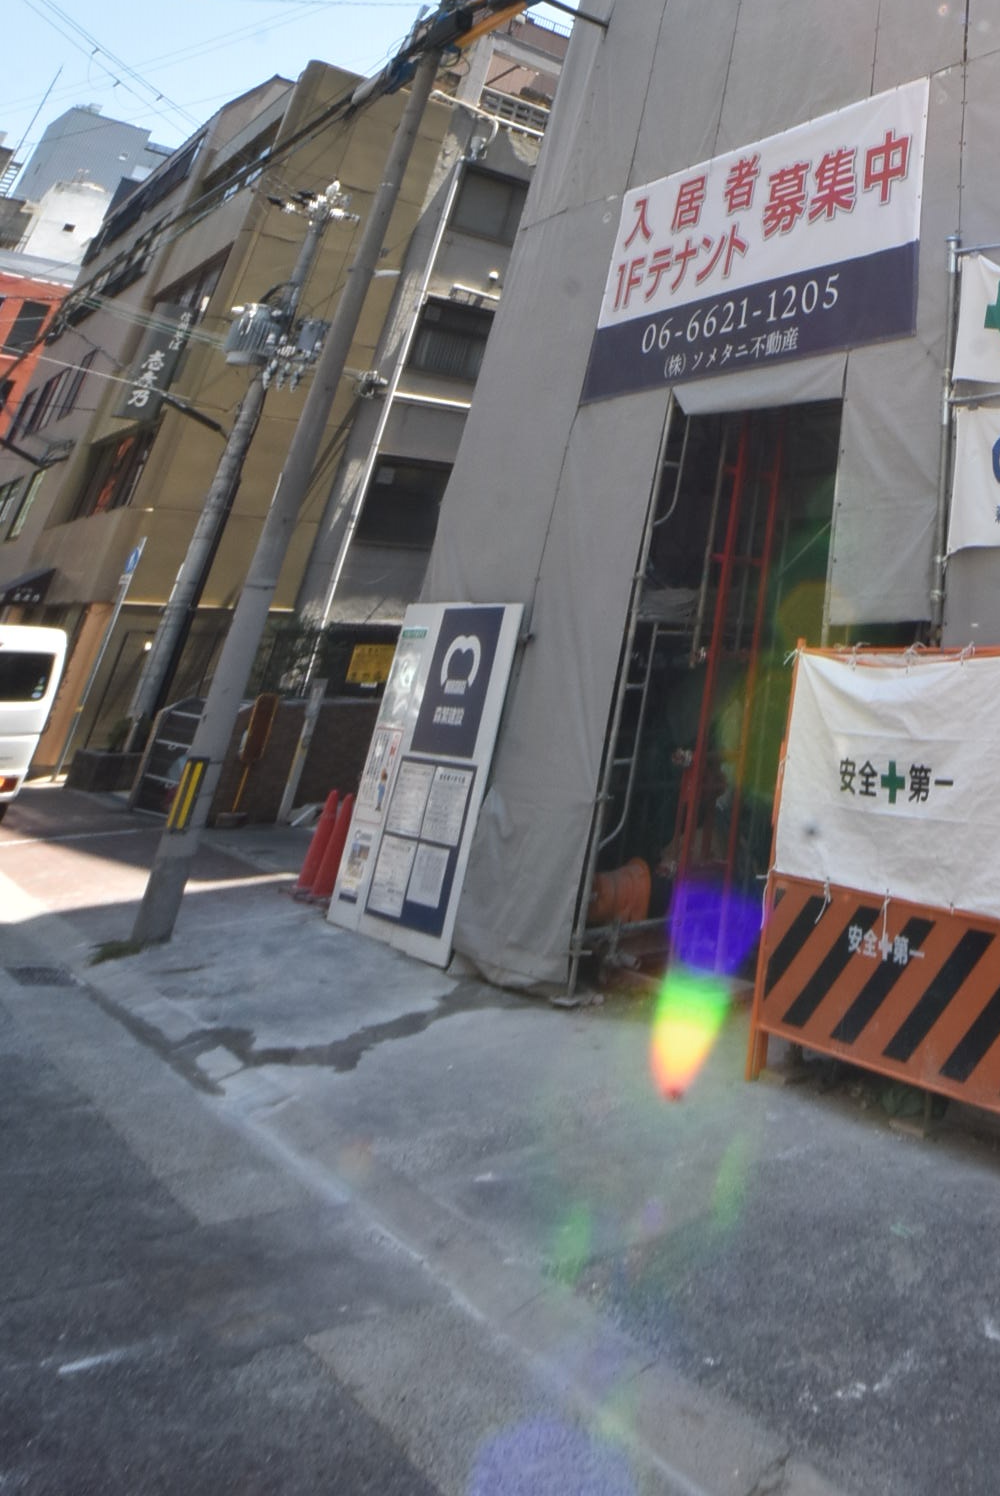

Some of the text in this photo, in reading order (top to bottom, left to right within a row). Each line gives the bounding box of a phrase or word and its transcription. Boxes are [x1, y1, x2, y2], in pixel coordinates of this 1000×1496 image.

[625, 154, 761, 248] 入居者
[762, 129, 911, 239] 募集中
[614, 223, 749, 310] 1Fテナント
[641, 273, 840, 354] 06-6621-1205
[838, 757, 954, 803] 安全 第一
